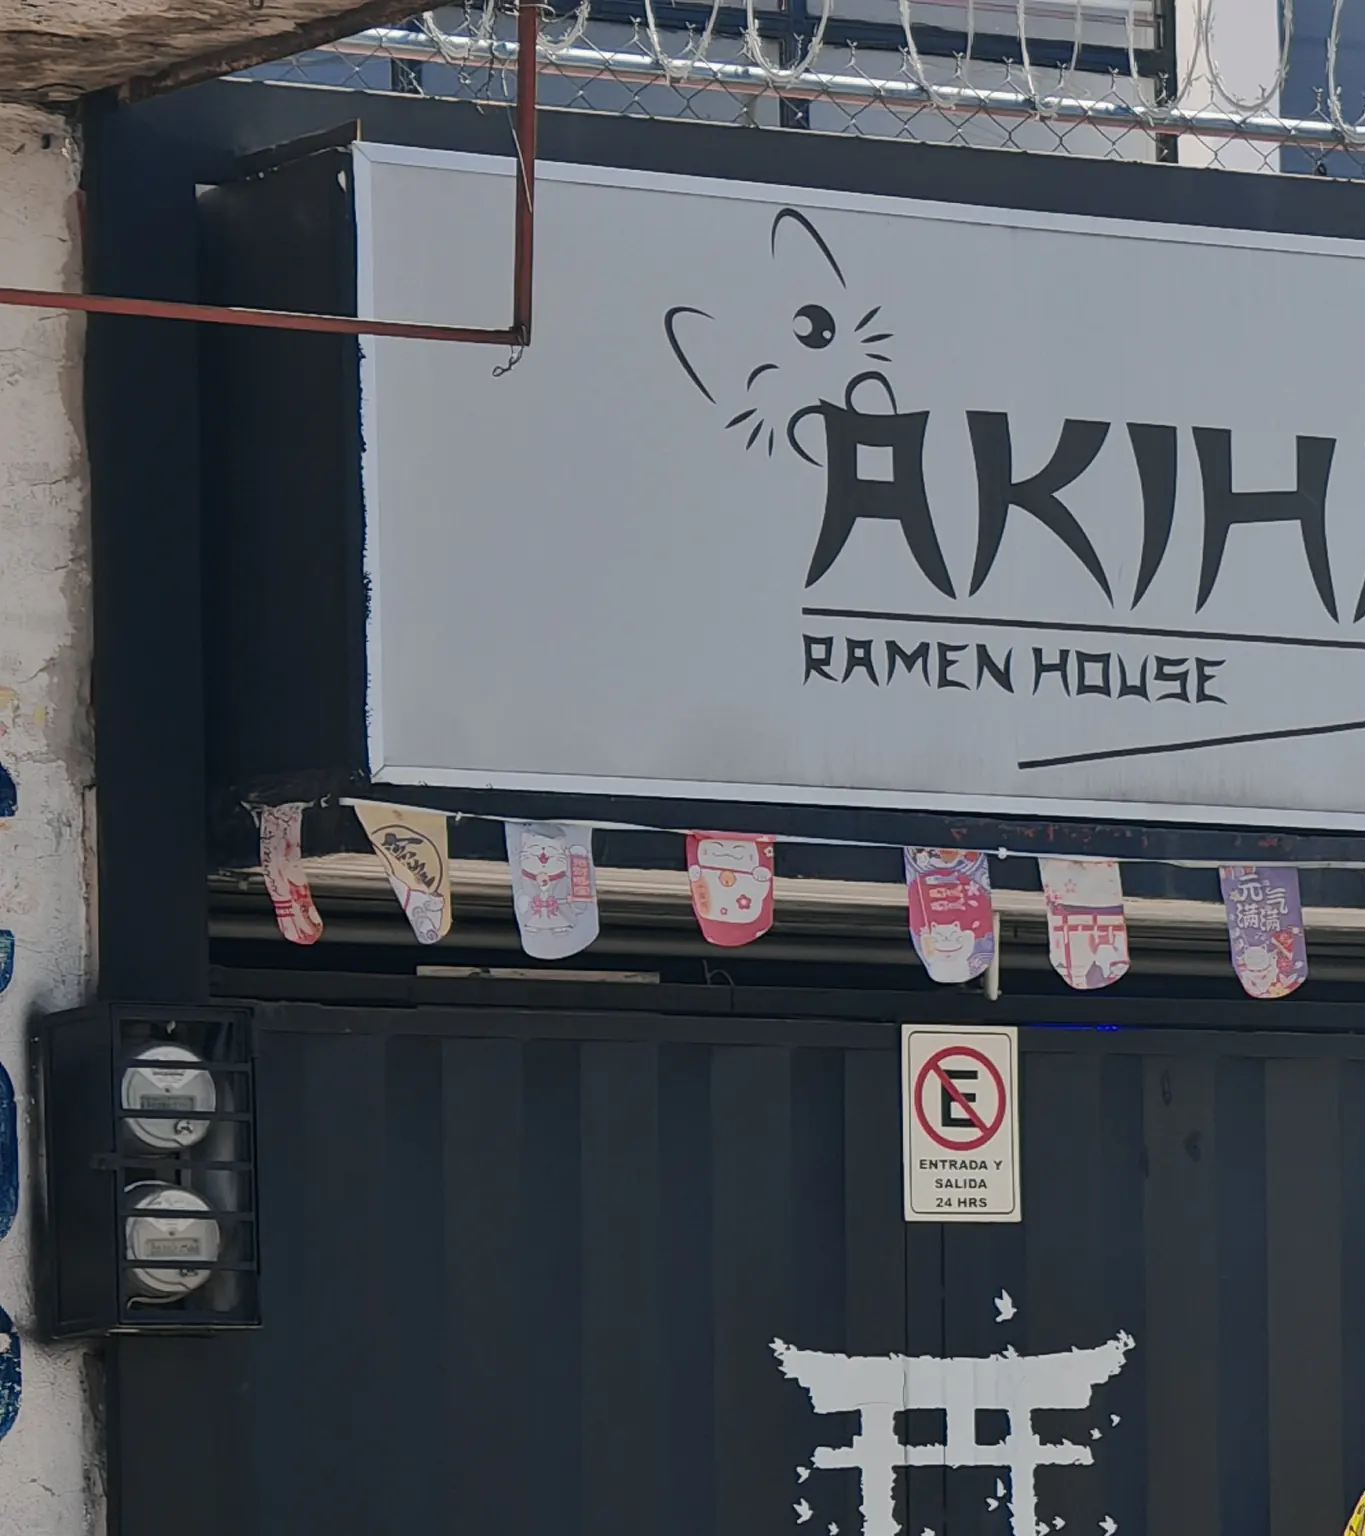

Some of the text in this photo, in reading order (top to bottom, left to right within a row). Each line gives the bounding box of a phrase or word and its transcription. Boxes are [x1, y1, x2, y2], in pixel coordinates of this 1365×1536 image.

[802, 634, 1227, 705] RAMEN HOUSE
[919, 1159, 1003, 1171] ENTRADA Y
[934, 1178, 988, 1189] SALIDA
[935, 1197, 988, 1208] 24 HRS
